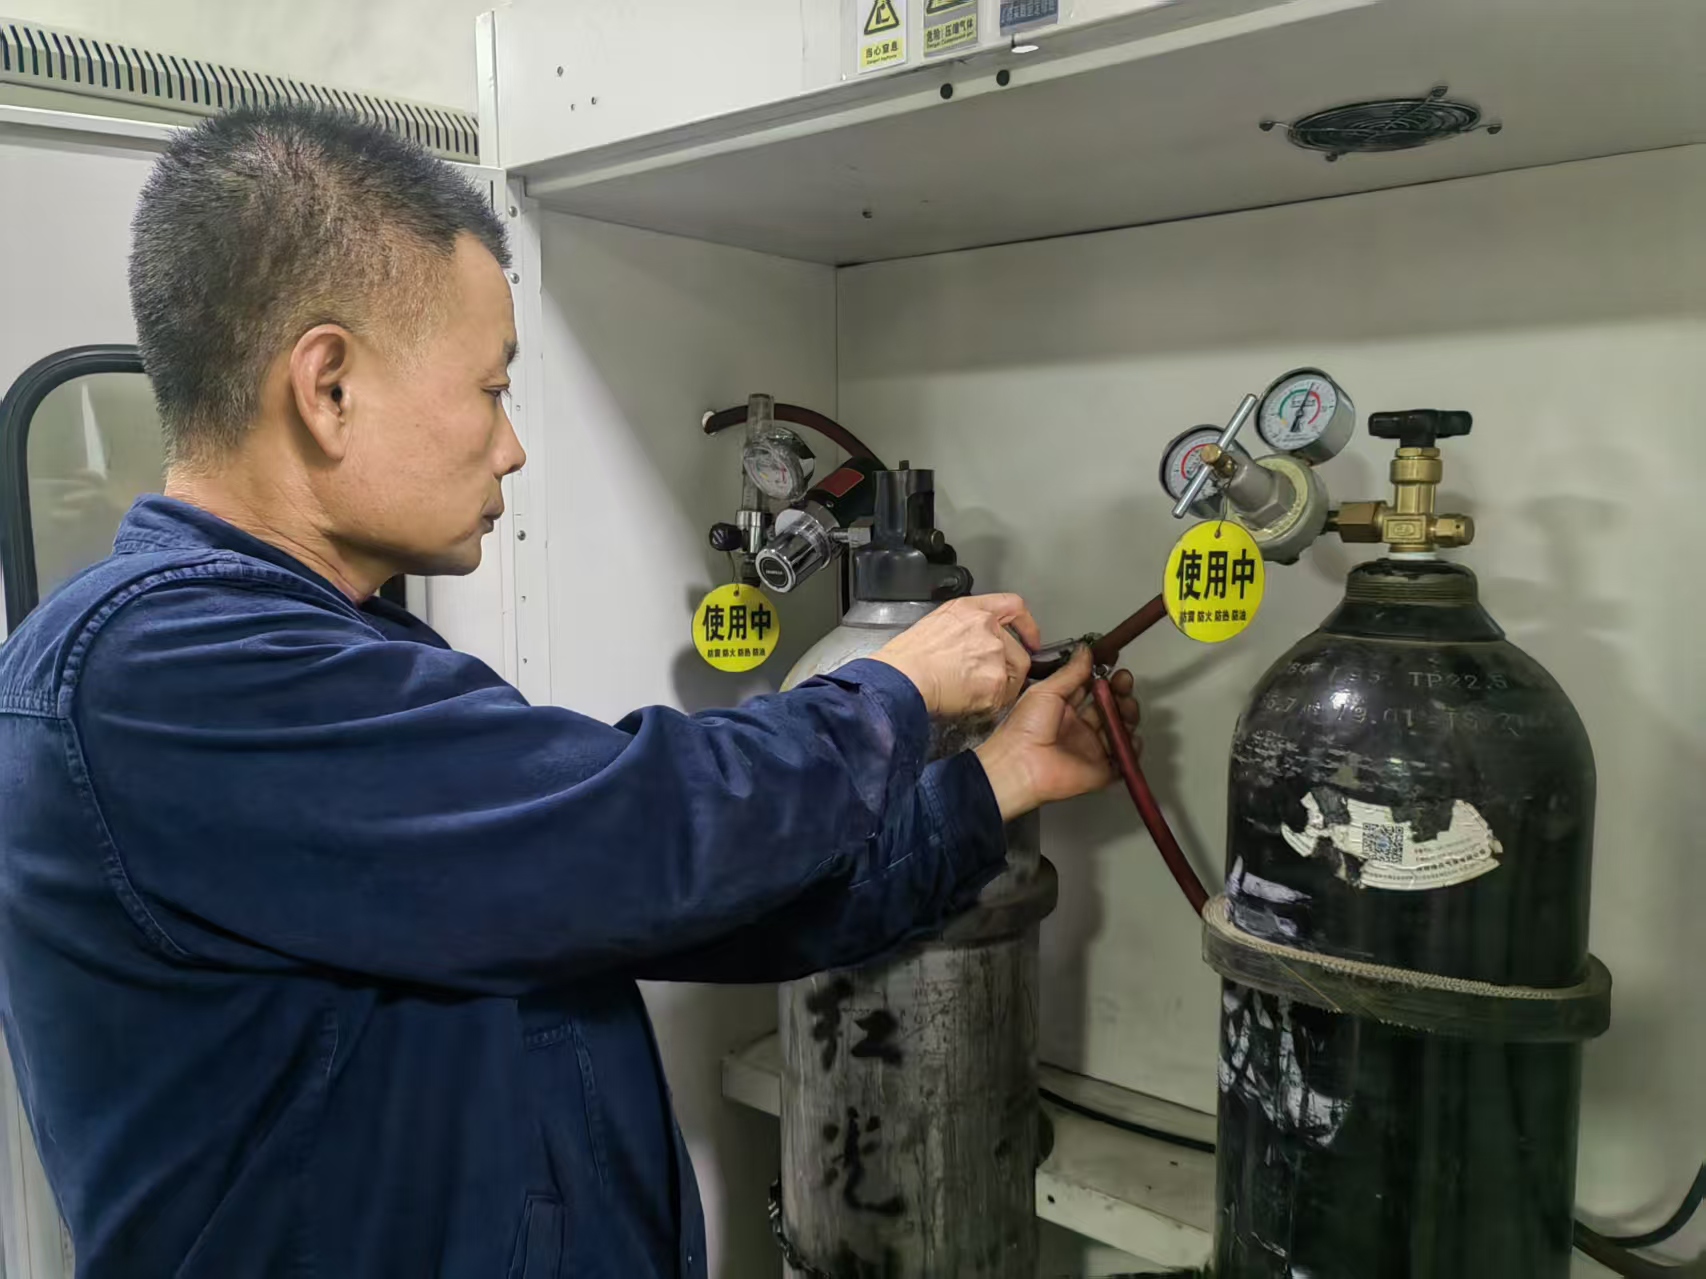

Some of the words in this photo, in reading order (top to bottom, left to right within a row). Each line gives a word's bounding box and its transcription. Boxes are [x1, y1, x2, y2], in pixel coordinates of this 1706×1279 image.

[1176, 548, 1256, 601] 使用中
[702, 602, 772, 642] 使用中
